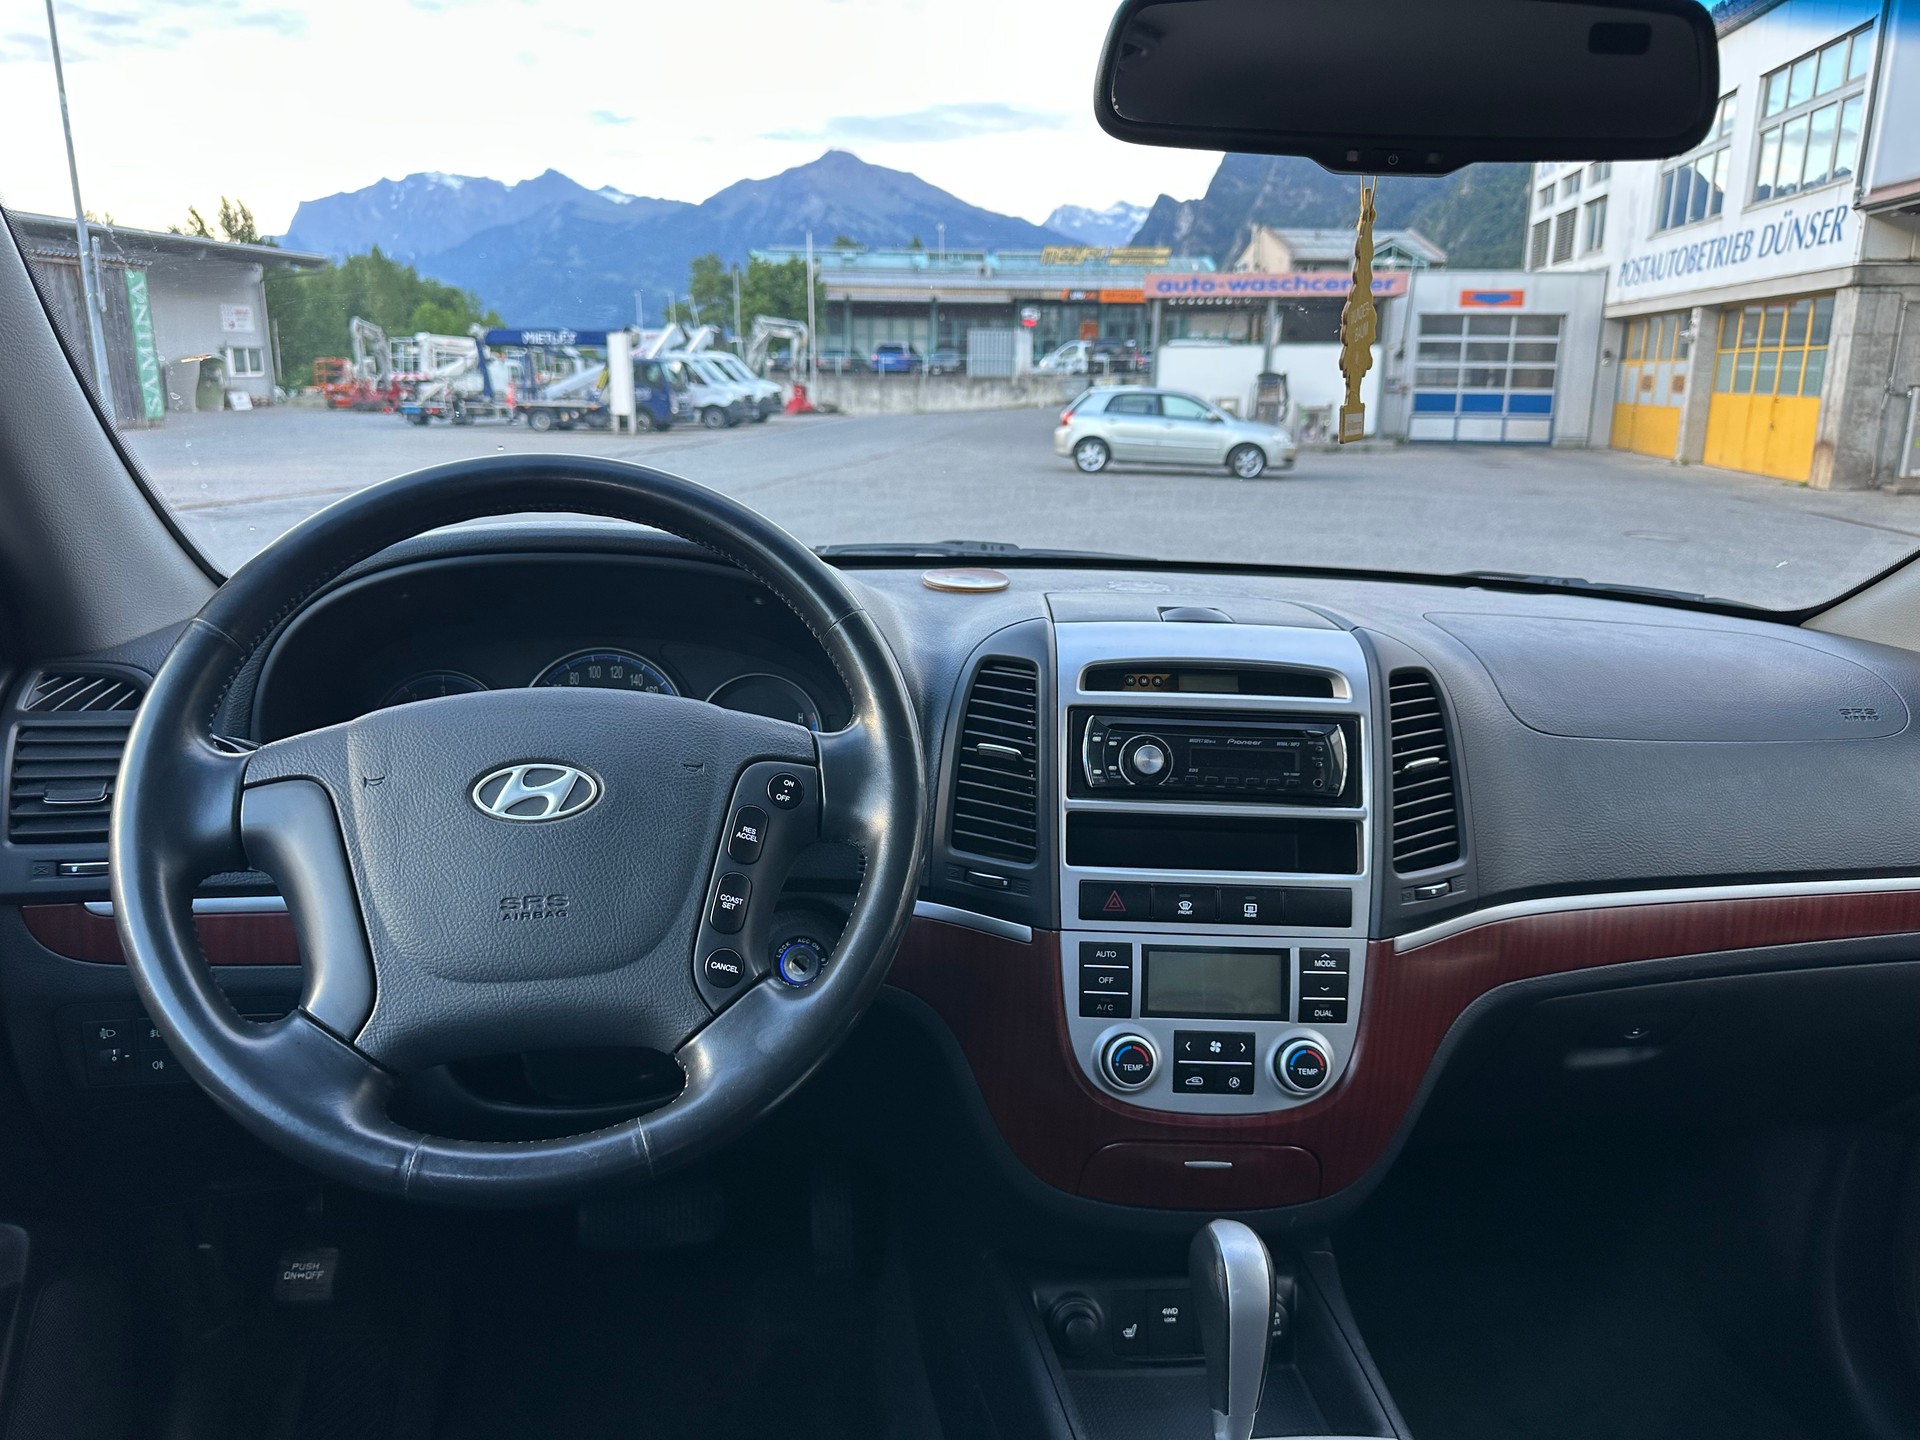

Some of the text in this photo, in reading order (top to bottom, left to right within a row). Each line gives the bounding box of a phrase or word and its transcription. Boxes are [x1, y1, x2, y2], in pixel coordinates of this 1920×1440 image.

[1617, 205, 1848, 287] POSTAUTOBETRIEB DÜNSER
[1156, 276, 1395, 293] auto-waschcener
[129, 278, 162, 412] SAMINA
[588, 666, 624, 679] 100 120
[569, 672, 643, 687] 80 140
[797, 712, 804, 723] H
[1227, 738, 1262, 746] Pioneer
[783, 779, 795, 788] ON
[775, 793, 791, 802] OFF
[742, 826, 757, 835] RES
[736, 831, 758, 843] ACCEL
[500, 894, 570, 910] SRS
[720, 893, 743, 905] COAST
[721, 901, 736, 911] SET
[502, 910, 569, 922] AIRBAG
[775, 941, 791, 958] LOCK
[811, 942, 821, 951] ON
[1095, 950, 1117, 958] AUTO
[710, 961, 739, 974] CANCEL
[1314, 959, 1337, 968] MODE
[1098, 976, 1114, 984] OFF
[1313, 1009, 1334, 1018] DUAL
[1122, 1063, 1144, 1072] TEMP
[1297, 1067, 1319, 1076] TEMP
[291, 1262, 321, 1271] PUSH
[1161, 1307, 1179, 1316] 4WD
